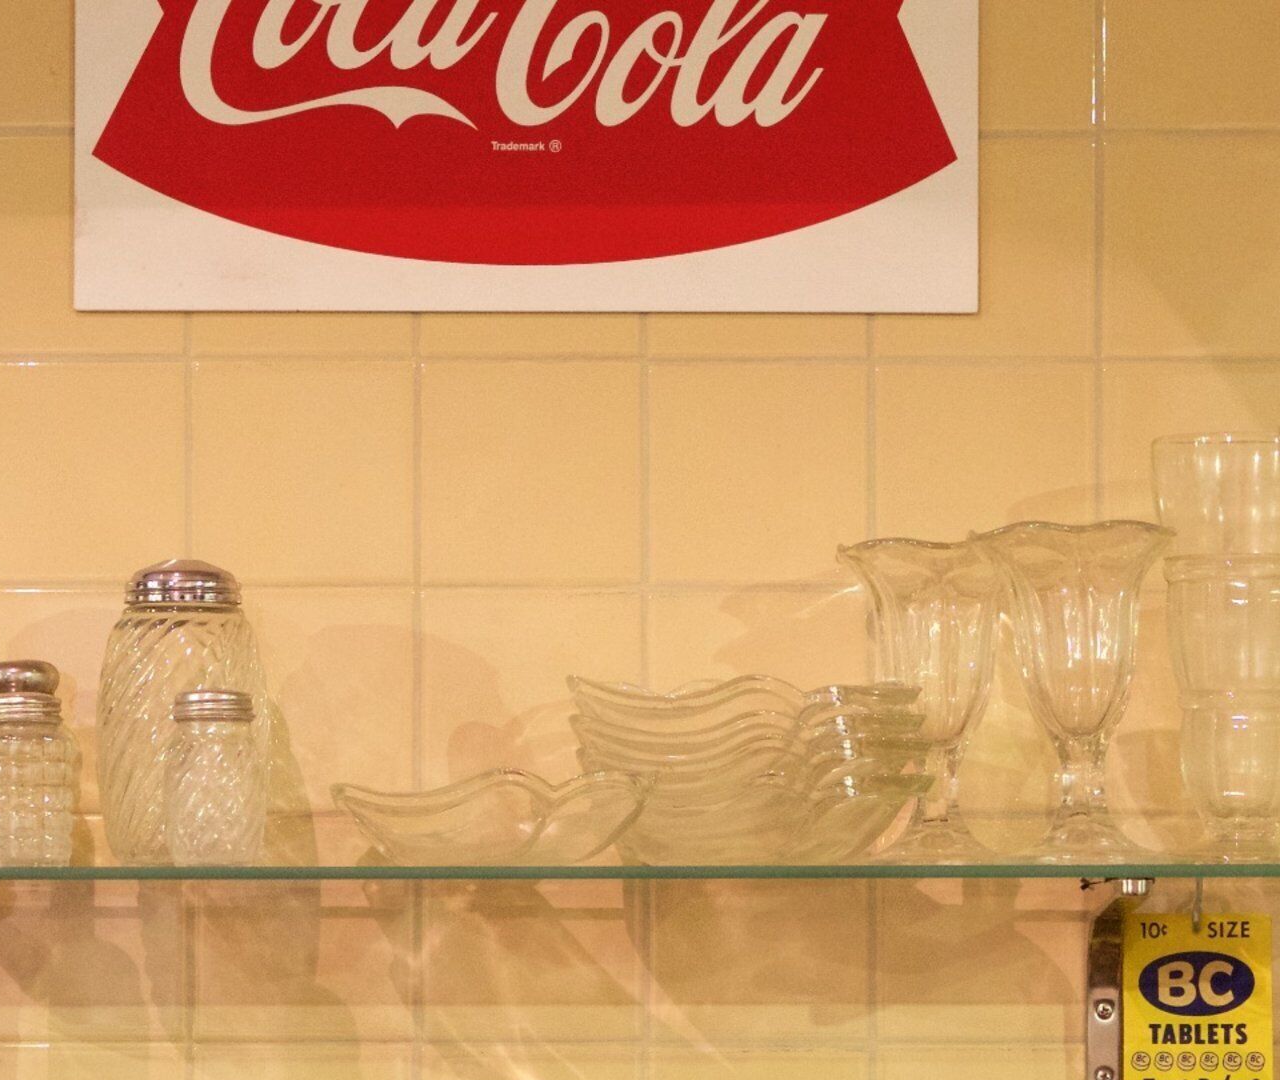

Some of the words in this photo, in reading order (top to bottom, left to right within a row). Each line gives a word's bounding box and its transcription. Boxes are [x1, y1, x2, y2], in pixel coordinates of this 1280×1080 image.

[180, 0, 828, 130] CocaCola
[491, 141, 545, 151] Trademark
[1208, 921, 1250, 938] SIZE
[1157, 960, 1234, 1007] BC
[1149, 1023, 1248, 1045] TABLETS
